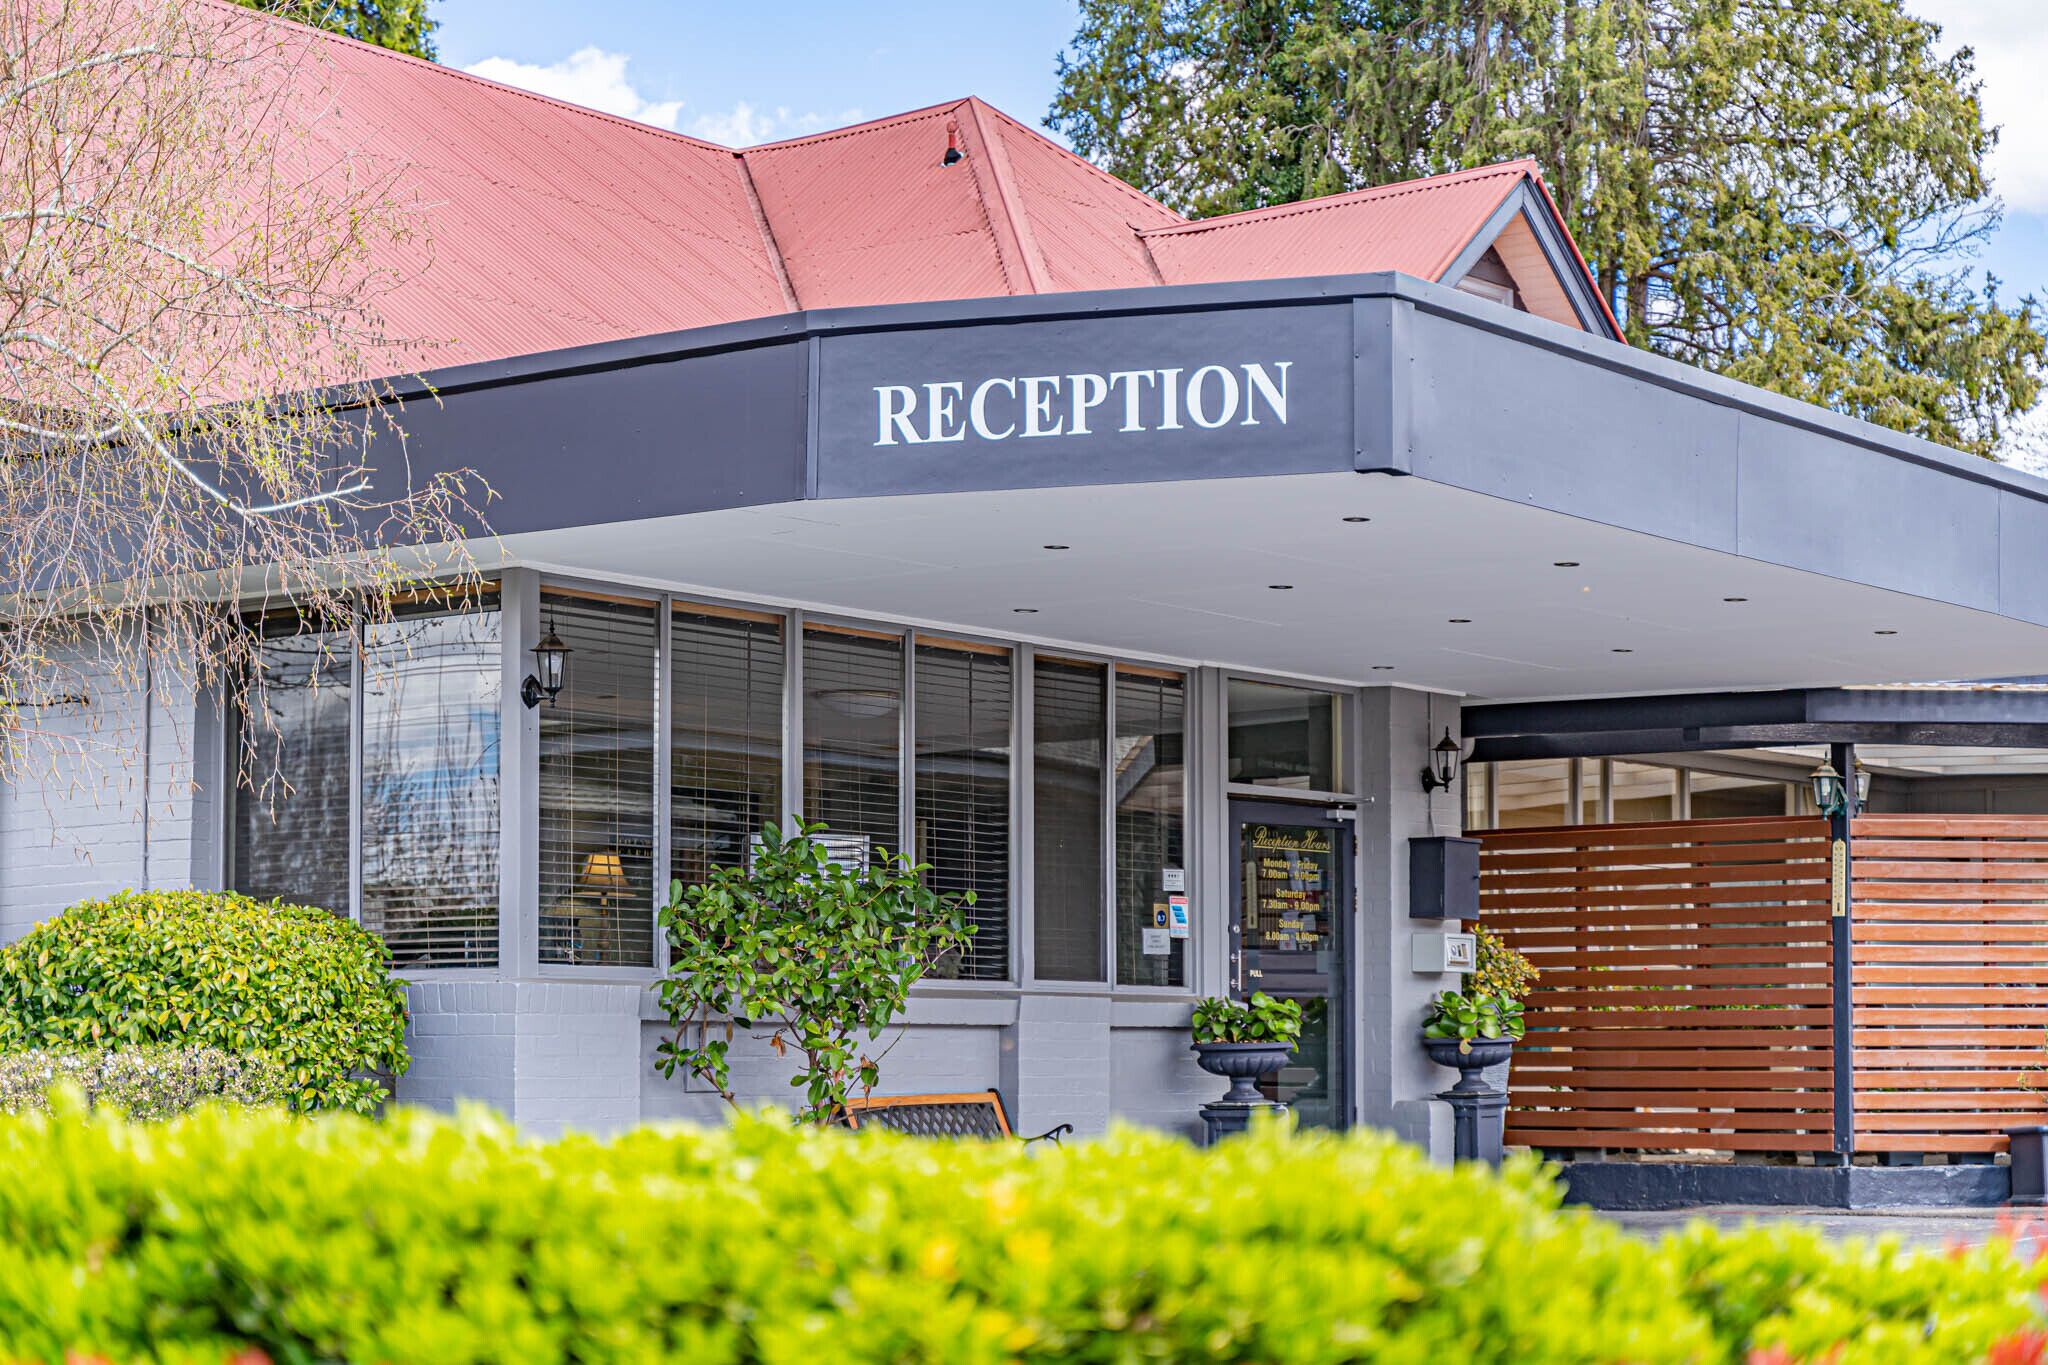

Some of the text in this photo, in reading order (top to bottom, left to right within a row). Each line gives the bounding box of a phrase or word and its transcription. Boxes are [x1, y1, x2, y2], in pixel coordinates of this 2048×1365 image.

[872, 361, 1293, 446] RECEPTION
[1253, 826, 1331, 853] Reception Hours
[1264, 858, 1290, 870] Monday
[1297, 860, 1318, 871] Friday
[1262, 869, 1288, 879] 7.00am
[1276, 888, 1306, 900] Saturday
[1262, 899, 1288, 909] 7.30am
[1294, 901, 1320, 912] 9.00pm
[1279, 919, 1304, 930] Sunday
[1265, 931, 1290, 941] 8.00am
[1249, 969, 1264, 978] PULL
